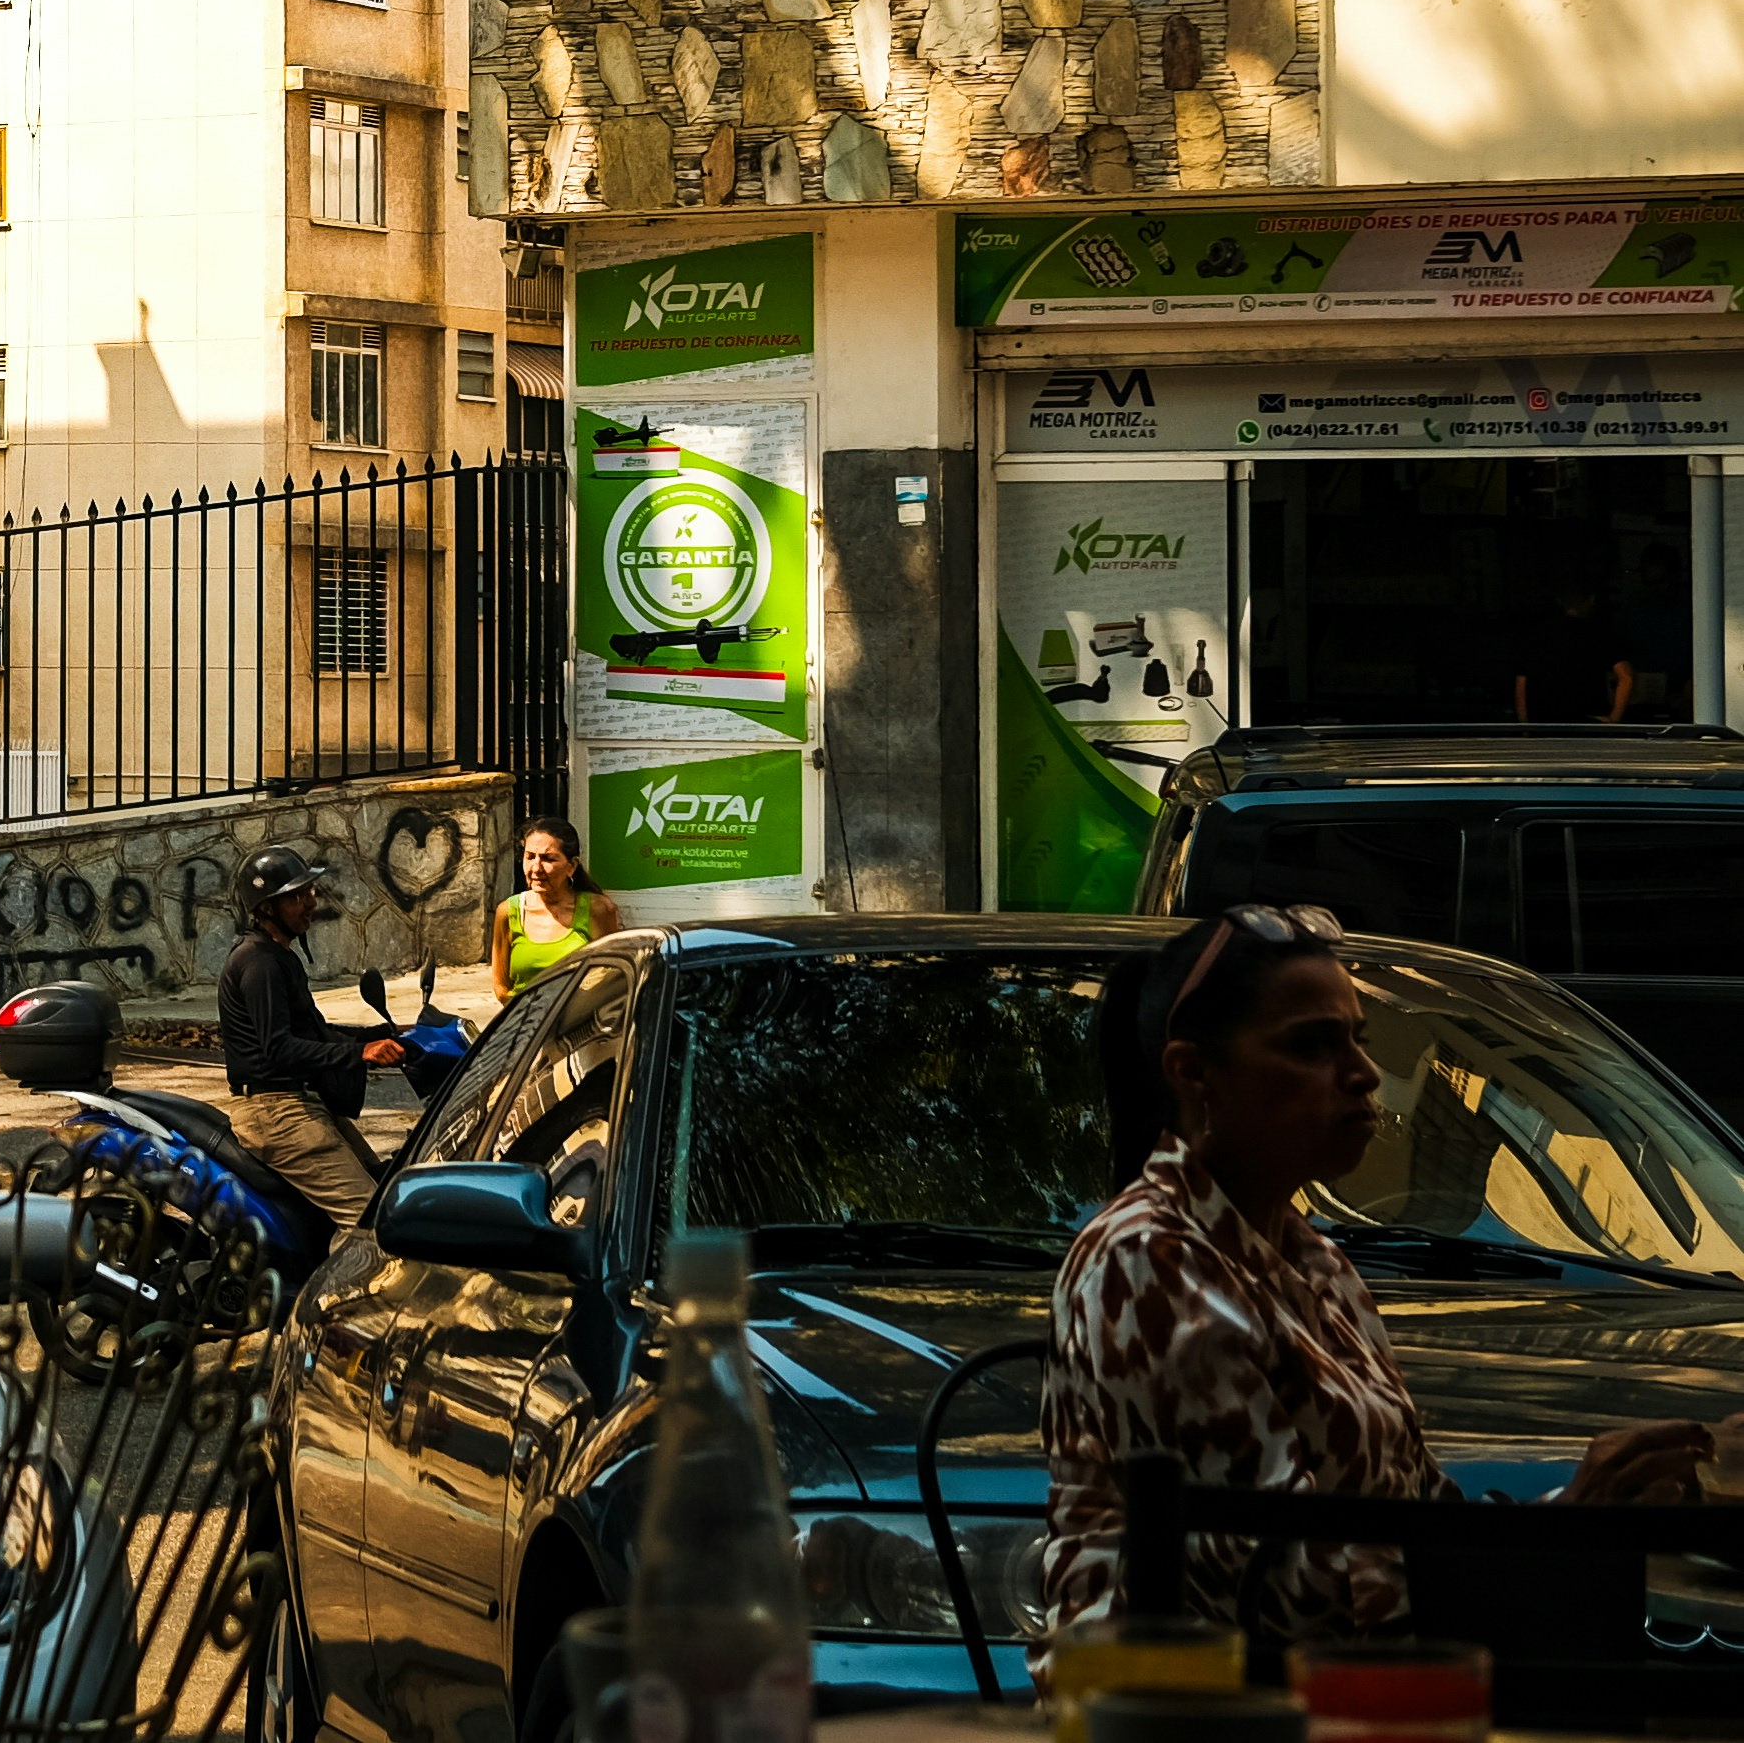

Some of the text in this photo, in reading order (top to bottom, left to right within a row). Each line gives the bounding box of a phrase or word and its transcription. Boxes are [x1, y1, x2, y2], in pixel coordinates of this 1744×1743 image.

[1256, 214, 1413, 234] DISTRIBUIDORES
[1416, 213, 1445, 229] DE
[1447, 210, 1560, 229] REPUESTOS
[1562, 209, 1618, 226] PARA
[1623, 208, 1650, 224] TU
[1422, 267, 1460, 280] MEGA
[1462, 265, 1512, 279] MOTRIZ
[623, 264, 767, 332] KOTAI
[1451, 294, 1475, 308] TU
[1477, 291, 1575, 308] REPUESTO
[1577, 290, 1604, 305] DE
[1607, 288, 1715, 305] CONFIANZA
[664, 311, 757, 324] AUTOPARTS
[590, 334, 802, 352] TU REPUESTO DE CONFIANZA
[1289, 392, 1516, 411] megamotrizccs@gmail.com
[1555, 389, 1702, 407] @megamotrizccs
[1029, 413, 1076, 428] MEGA
[1079, 411, 1143, 427] MOTRIZ
[1089, 429, 1157, 439] CARACAS
[1267, 420, 1729, 440] (0424)622.17.61 (0212)751.10.38 (0212)753.99.91
[1053, 516, 1186, 575] KOTAI
[619, 544, 755, 566] GARANTÍA
[1091, 560, 1178, 570] AUTOPARTS
[625, 774, 765, 840] KOTAI
[666, 823, 758, 834] AUTOPARTS
[653, 846, 749, 860] www.kotai.com.ve
